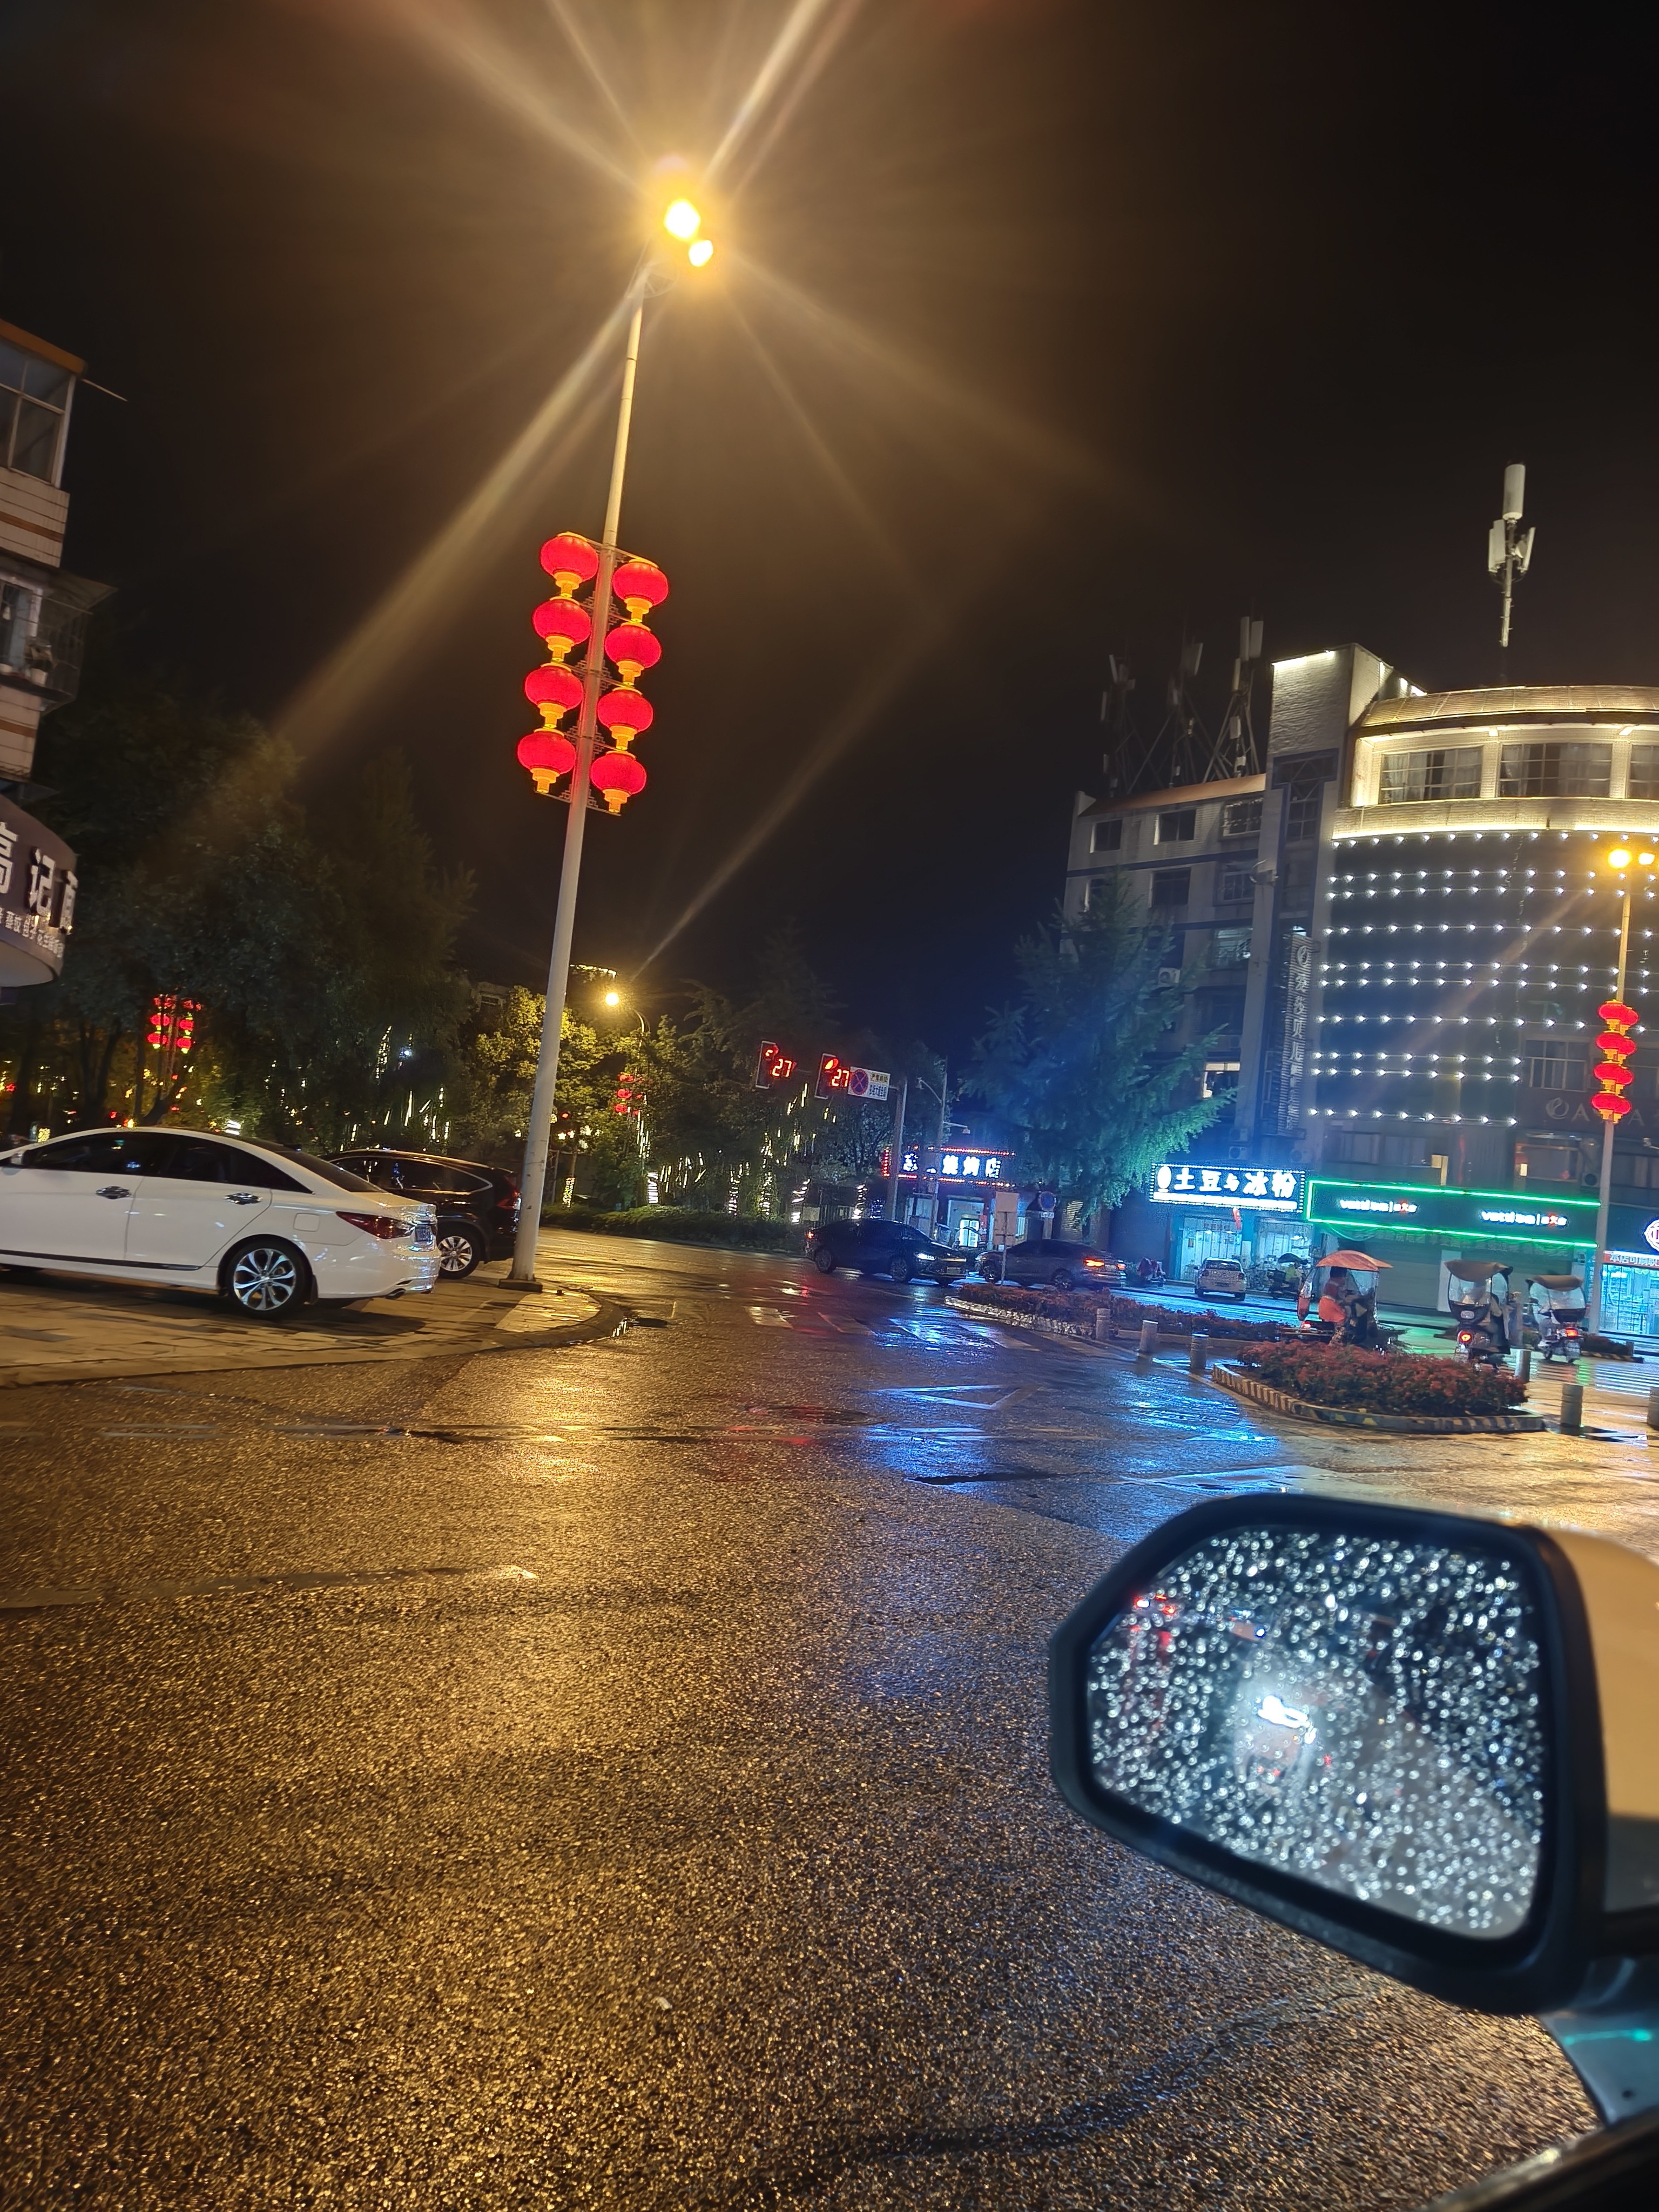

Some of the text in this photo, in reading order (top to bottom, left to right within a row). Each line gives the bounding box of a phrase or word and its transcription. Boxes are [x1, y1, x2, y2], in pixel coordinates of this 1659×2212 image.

[772, 1058, 792, 1077] 27
[832, 1069, 849, 1087] 27
[1174, 1167, 1297, 1198] 土豆与冰粉
